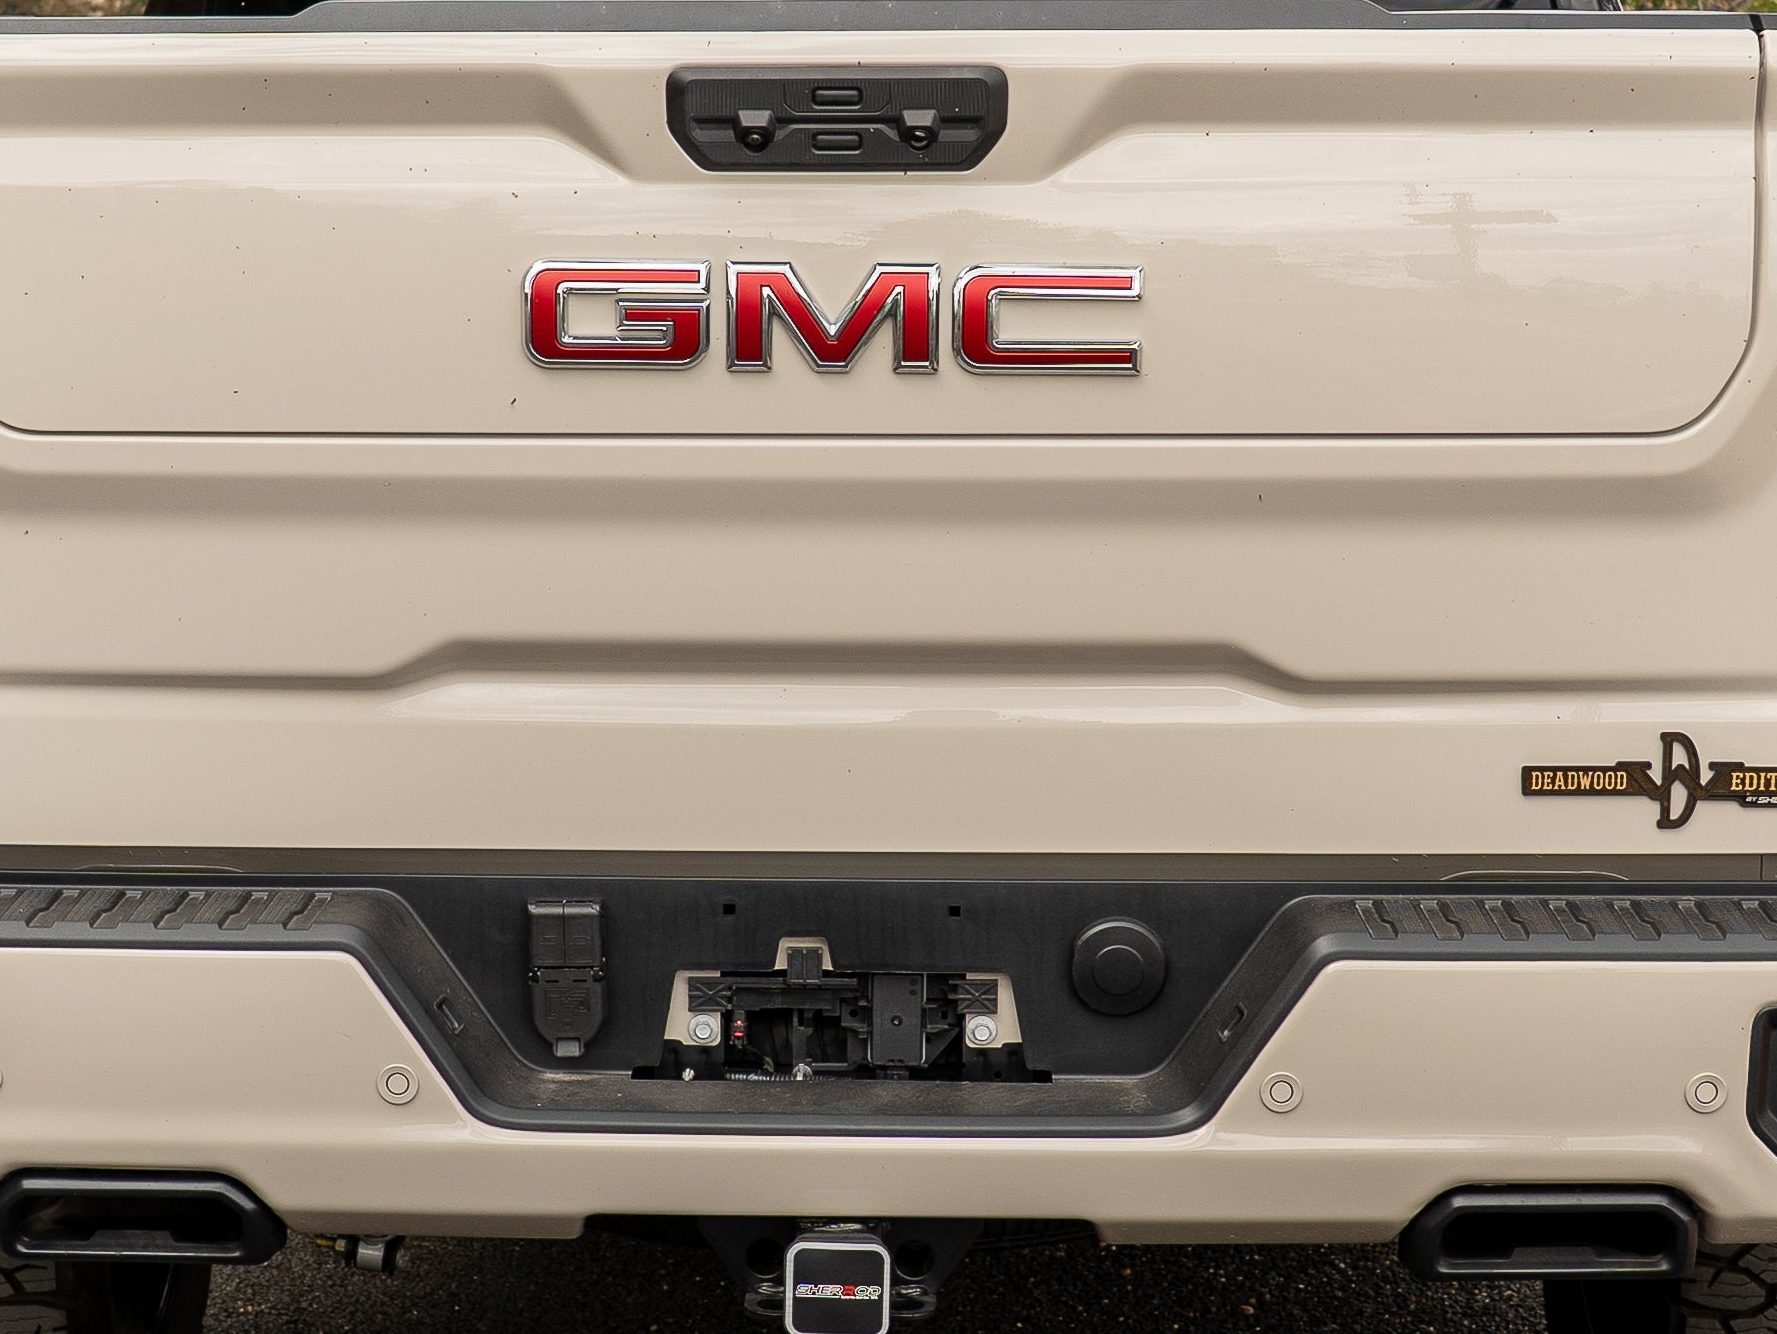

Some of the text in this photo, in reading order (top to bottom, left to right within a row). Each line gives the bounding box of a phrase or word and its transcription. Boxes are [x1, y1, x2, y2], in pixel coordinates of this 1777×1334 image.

[521, 259, 1144, 376] GMC
[1530, 771, 1628, 791] DEADWOOD
[795, 1283, 882, 1298] SHERROD
